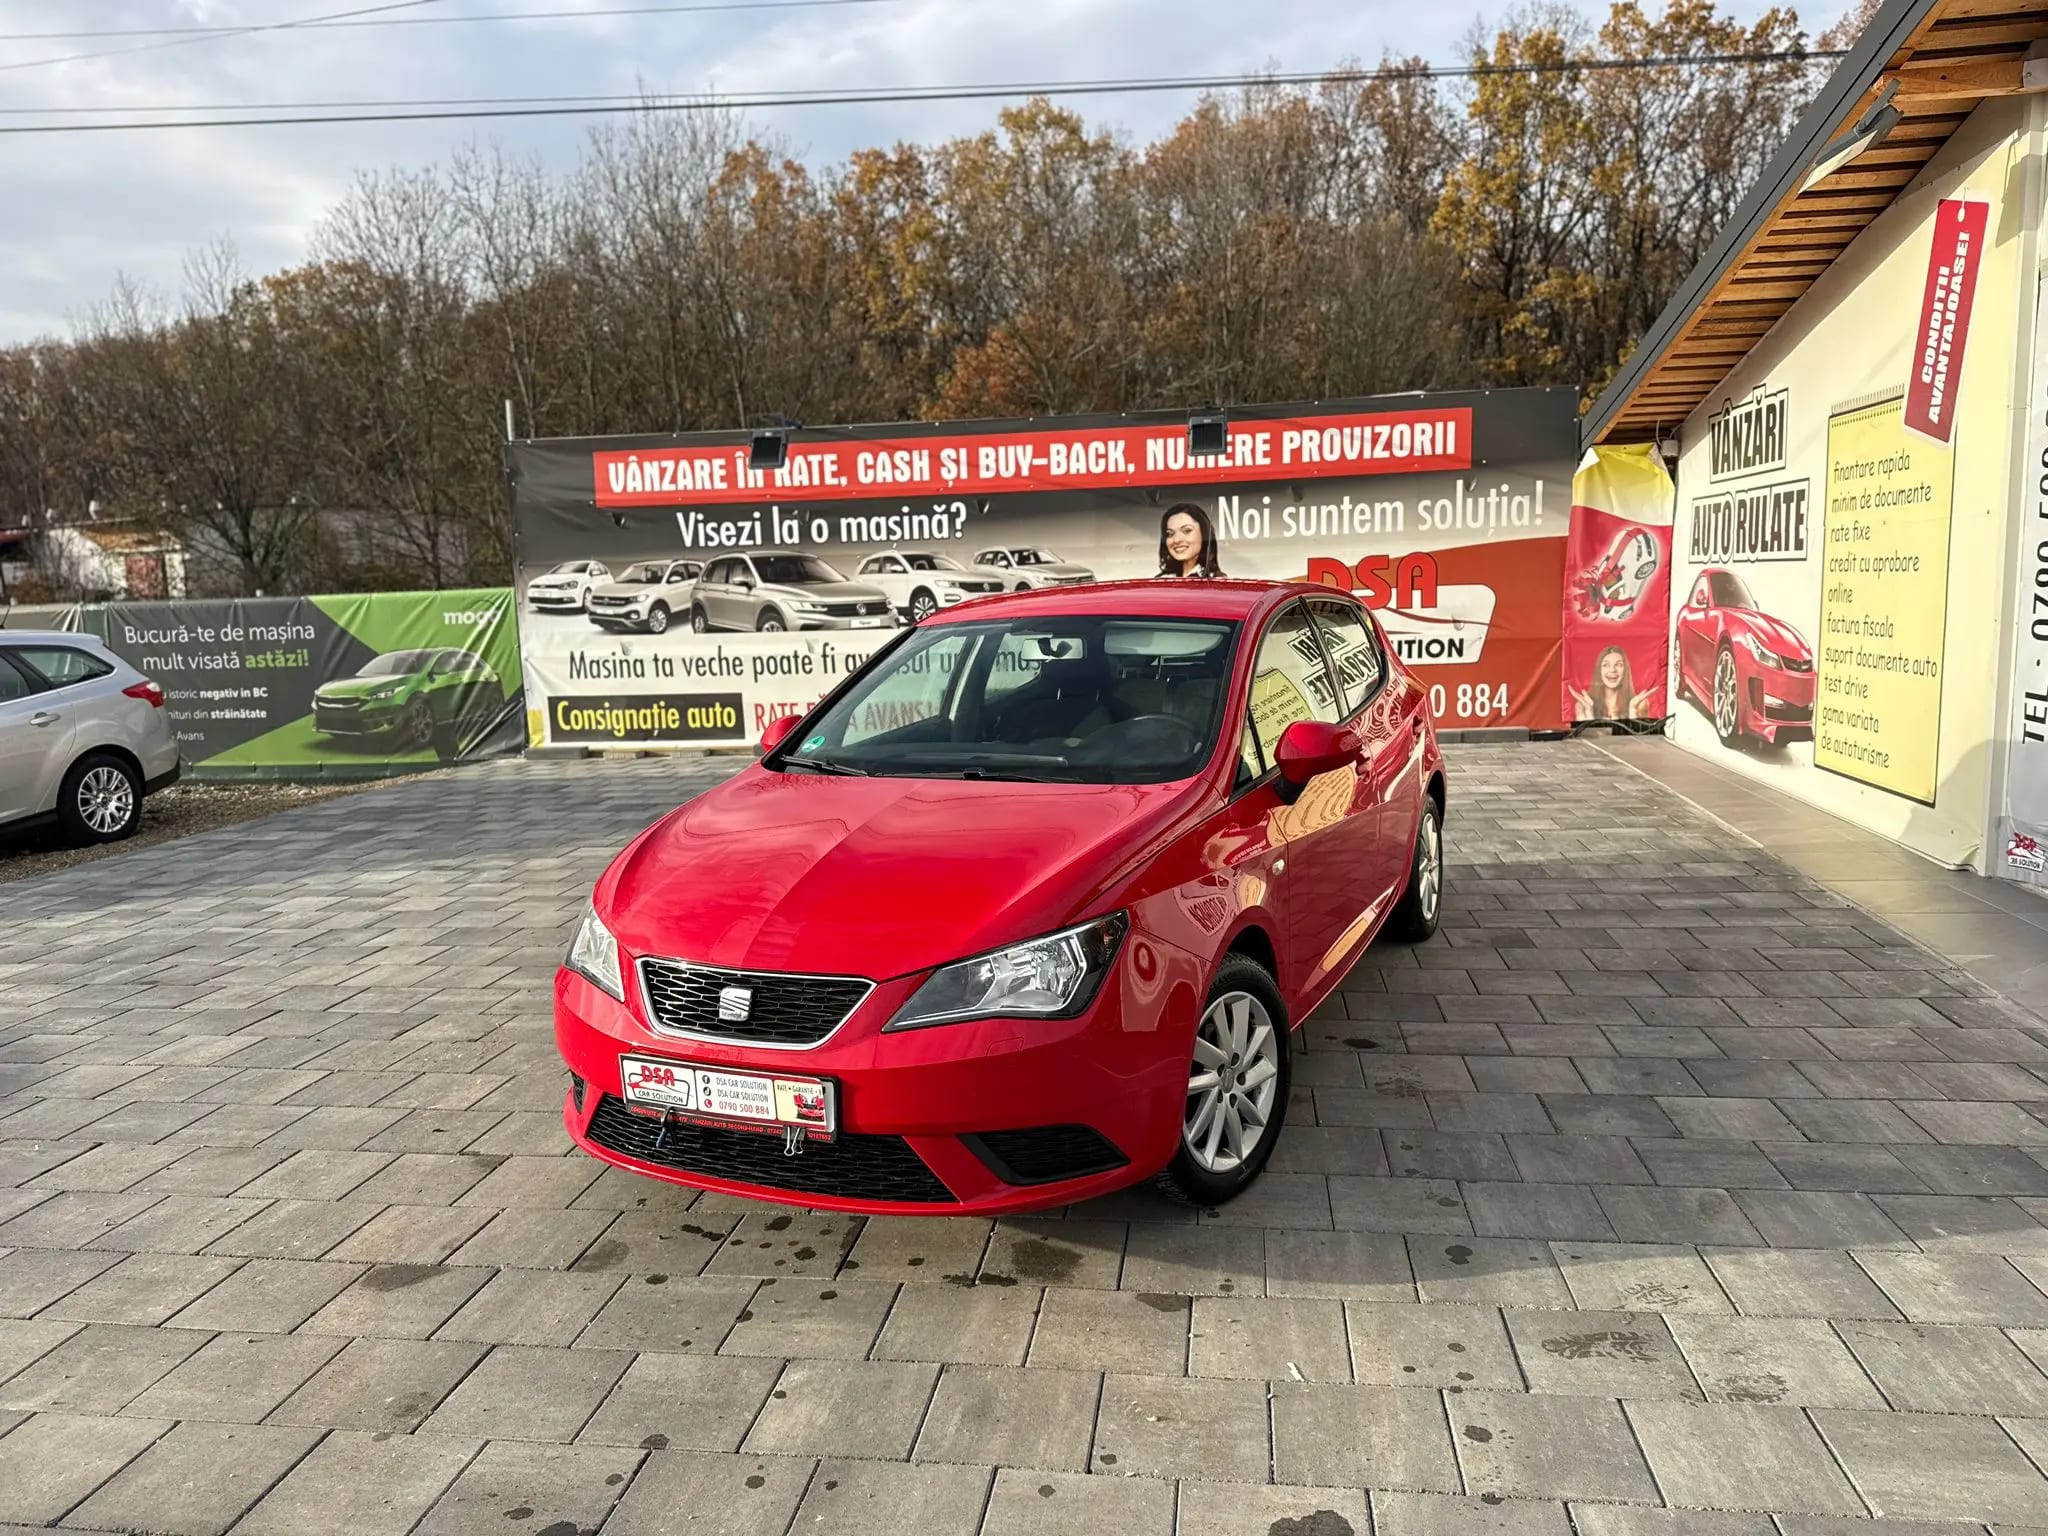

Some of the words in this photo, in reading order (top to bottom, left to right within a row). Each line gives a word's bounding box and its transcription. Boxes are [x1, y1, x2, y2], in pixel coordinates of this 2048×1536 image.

[1922, 266, 1950, 384] CONDITII
[1711, 394, 1785, 475] VÂNZĂRI
[608, 455, 728, 494] VÂNZARE
[774, 454, 848, 488] RATE,
[857, 449, 930, 484] CASH
[940, 448, 968, 489] ȘI
[1282, 421, 1456, 464] PROVIZORII
[1834, 460, 1874, 484] finantare
[1878, 448, 1910, 480] rapida
[1218, 495, 1271, 540] Noi
[1282, 495, 1404, 538] suntem
[1417, 479, 1544, 537] soluția!
[1832, 491, 1857, 513] minim
[1860, 488, 1871, 510] de
[1874, 482, 1932, 507] documente
[676, 510, 762, 548] Visezi
[772, 505, 799, 545] la
[811, 516, 829, 544] o
[841, 501, 967, 549] mașină?
[1692, 501, 1731, 556] AUTO
[1736, 489, 1806, 554] RULATE
[1830, 525, 1849, 543] rate
[1853, 520, 1870, 543] fixe
[1830, 551, 1857, 573] credit
[1859, 557, 1870, 573] cu
[1872, 549, 1920, 579] aprobare
[1828, 582, 1853, 604] online
[124, 625, 215, 644] Bucură-te
[220, 623, 244, 642] de
[249, 621, 315, 645] mașina
[1827, 612, 1860, 635] factura
[1863, 614, 1894, 638] fiscala
[142, 652, 185, 670] mult
[188, 651, 240, 670] visată
[245, 649, 309, 669] astăzi!
[654, 654, 674, 678] ta
[683, 645, 744, 677] veche
[753, 650, 813, 683] poate
[821, 642, 837, 675] fi
[1825, 647, 1853, 669] suport
[1856, 644, 1909, 674] documente
[1912, 656, 1937, 678] auto
[169, 689, 198, 699] istoric
[200, 687, 239, 701] negativ
[240, 687, 251, 698] in
[253, 687, 268, 698] BC
[1456, 682, 1509, 717] 884
[1825, 673, 1842, 693] test
[1845, 674, 1868, 699] drive
[193, 710, 209, 719] din
[210, 708, 267, 719] străinătate
[557, 700, 680, 737] Consignație
[688, 702, 736, 729] auto
[1822, 705, 1844, 727] gama
[1847, 709, 1879, 733] variata
[2022, 691, 2048, 744] TEL
[176, 730, 205, 741] Avans
[1822, 730, 1831, 750] de
[1834, 737, 1889, 769] autoturisme
[641, 1065, 675, 1087] DSA
[716, 1077, 727, 1086] DSA
[728, 1078, 738, 1087] CAR
[740, 1080, 767, 1091] SOLUTION
[652, 1092, 684, 1103] SOLUTION
[717, 1089, 728, 1098] DSA
[729, 1090, 739, 1099] CAR
[741, 1092, 768, 1103] SOLUTION
[719, 1101, 737, 1111] 0790
[739, 1103, 753, 1113] 500
[755, 1105, 769, 1115] 884
